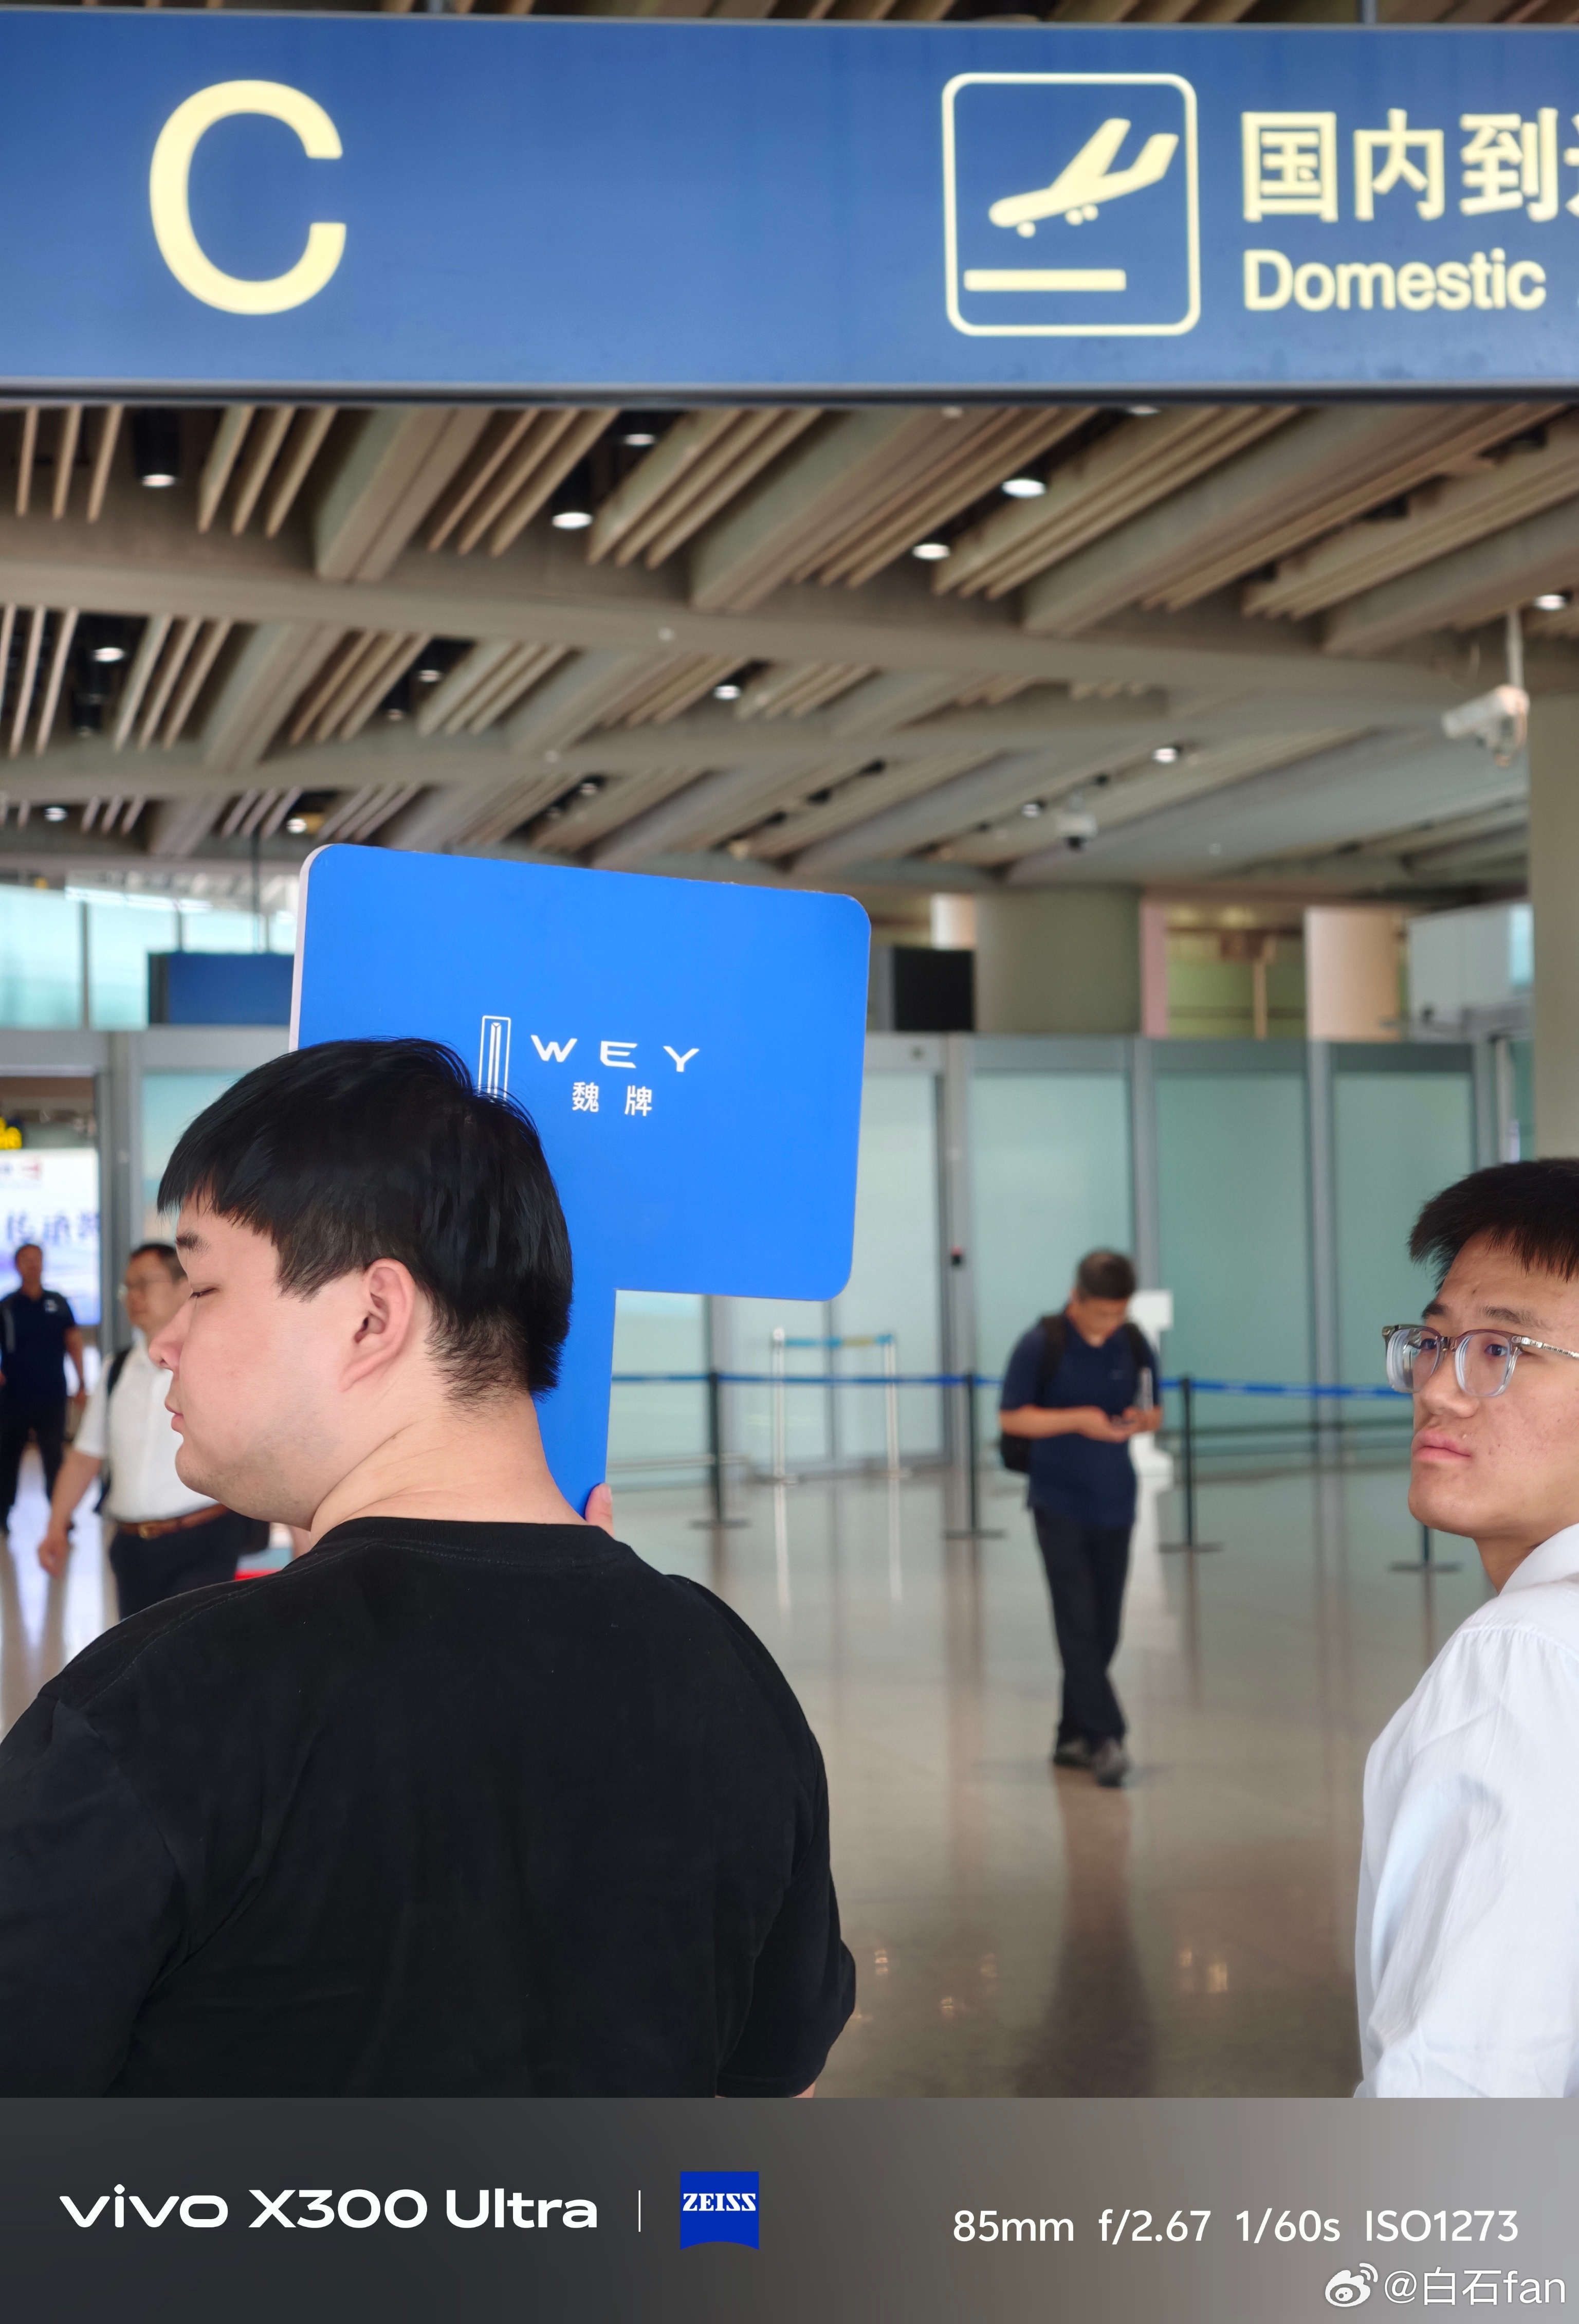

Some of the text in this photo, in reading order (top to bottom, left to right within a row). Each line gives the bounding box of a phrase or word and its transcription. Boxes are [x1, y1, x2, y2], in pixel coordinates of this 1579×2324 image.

[149, 79, 346, 316] C
[1241, 107, 1579, 223] 国内到
[1243, 247, 1547, 312] Domestic
[530, 1034, 700, 1073] WEY
[572, 1081, 653, 1117] 魏牌
